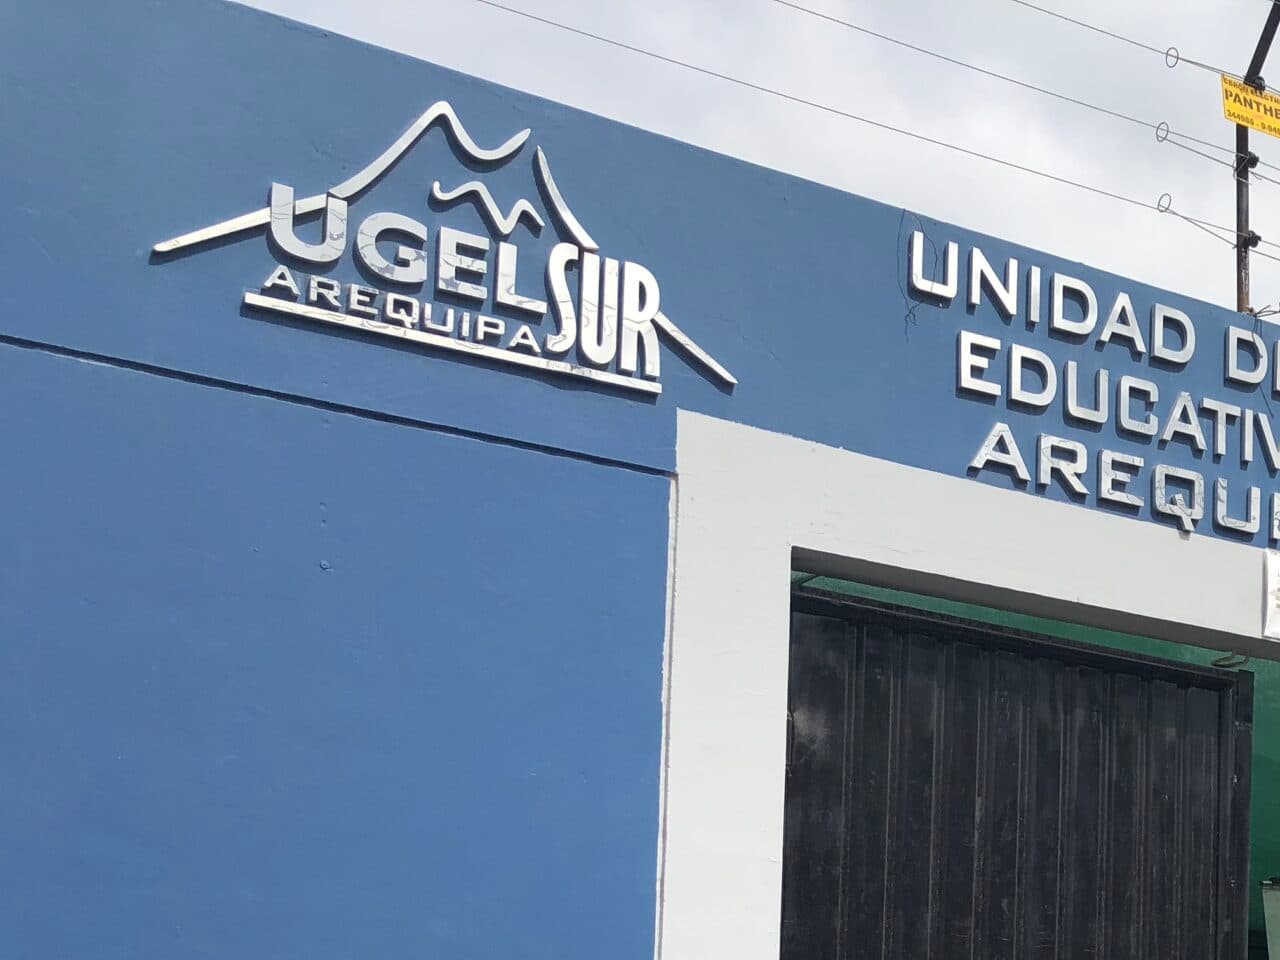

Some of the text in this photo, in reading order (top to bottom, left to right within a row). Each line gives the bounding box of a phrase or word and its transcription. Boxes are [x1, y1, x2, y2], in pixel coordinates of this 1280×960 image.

[262, 264, 542, 355] AREQUIPA
[269, 182, 662, 377] UGEL SUR
[908, 230, 1196, 365] UNIDAD
